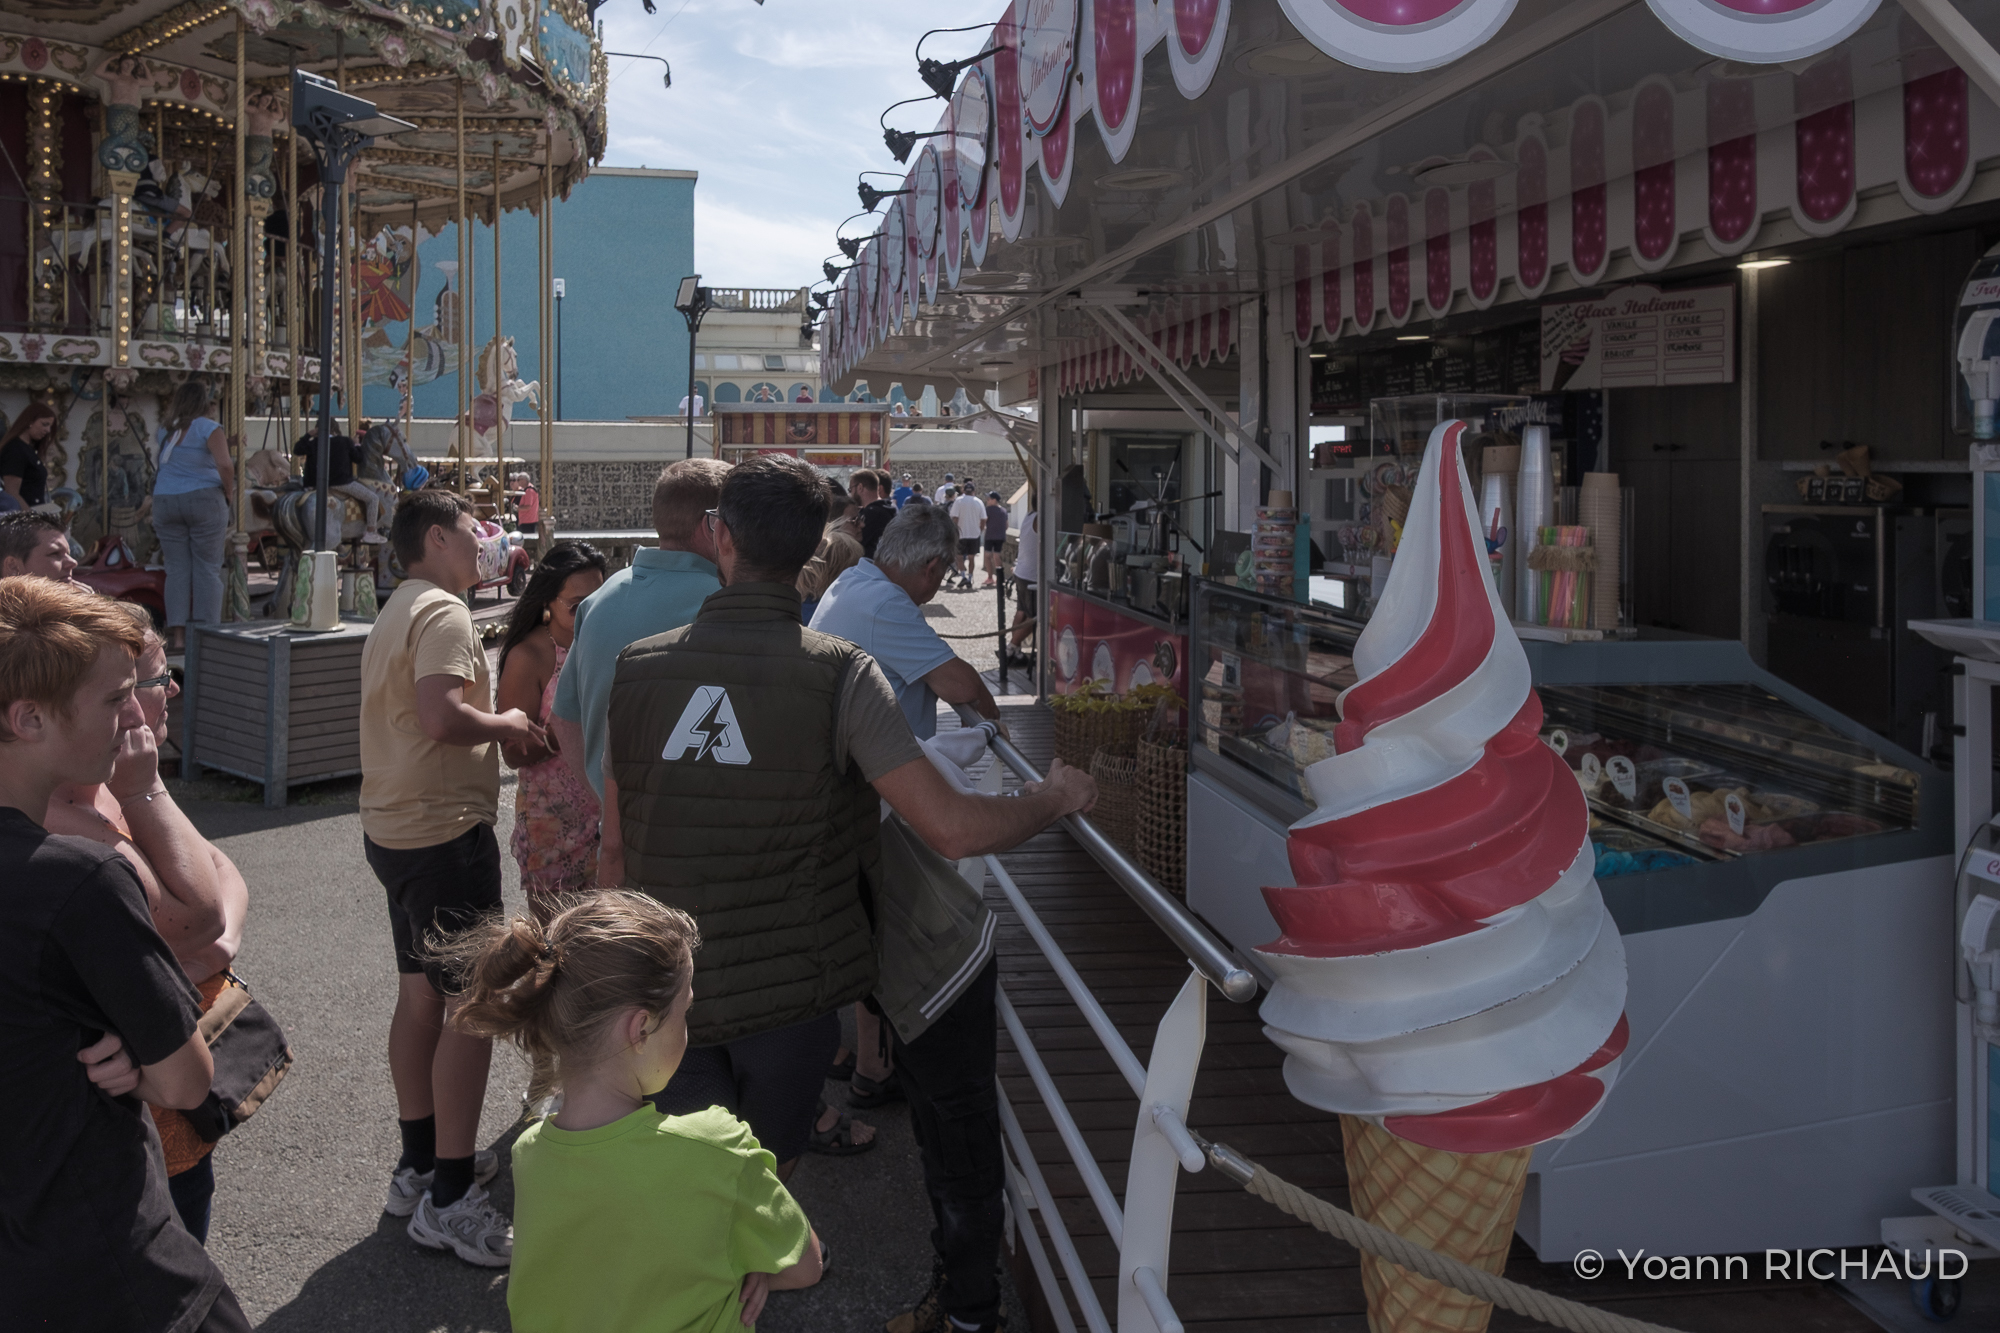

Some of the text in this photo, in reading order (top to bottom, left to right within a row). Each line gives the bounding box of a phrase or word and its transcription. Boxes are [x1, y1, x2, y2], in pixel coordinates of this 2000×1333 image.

[1574, 297, 1695, 324] Glace Italienne
[1606, 320, 1637, 330] VANILLE
[1604, 332, 1638, 343] CHOCOLAT
[1604, 348, 1635, 360] ABRICOT
